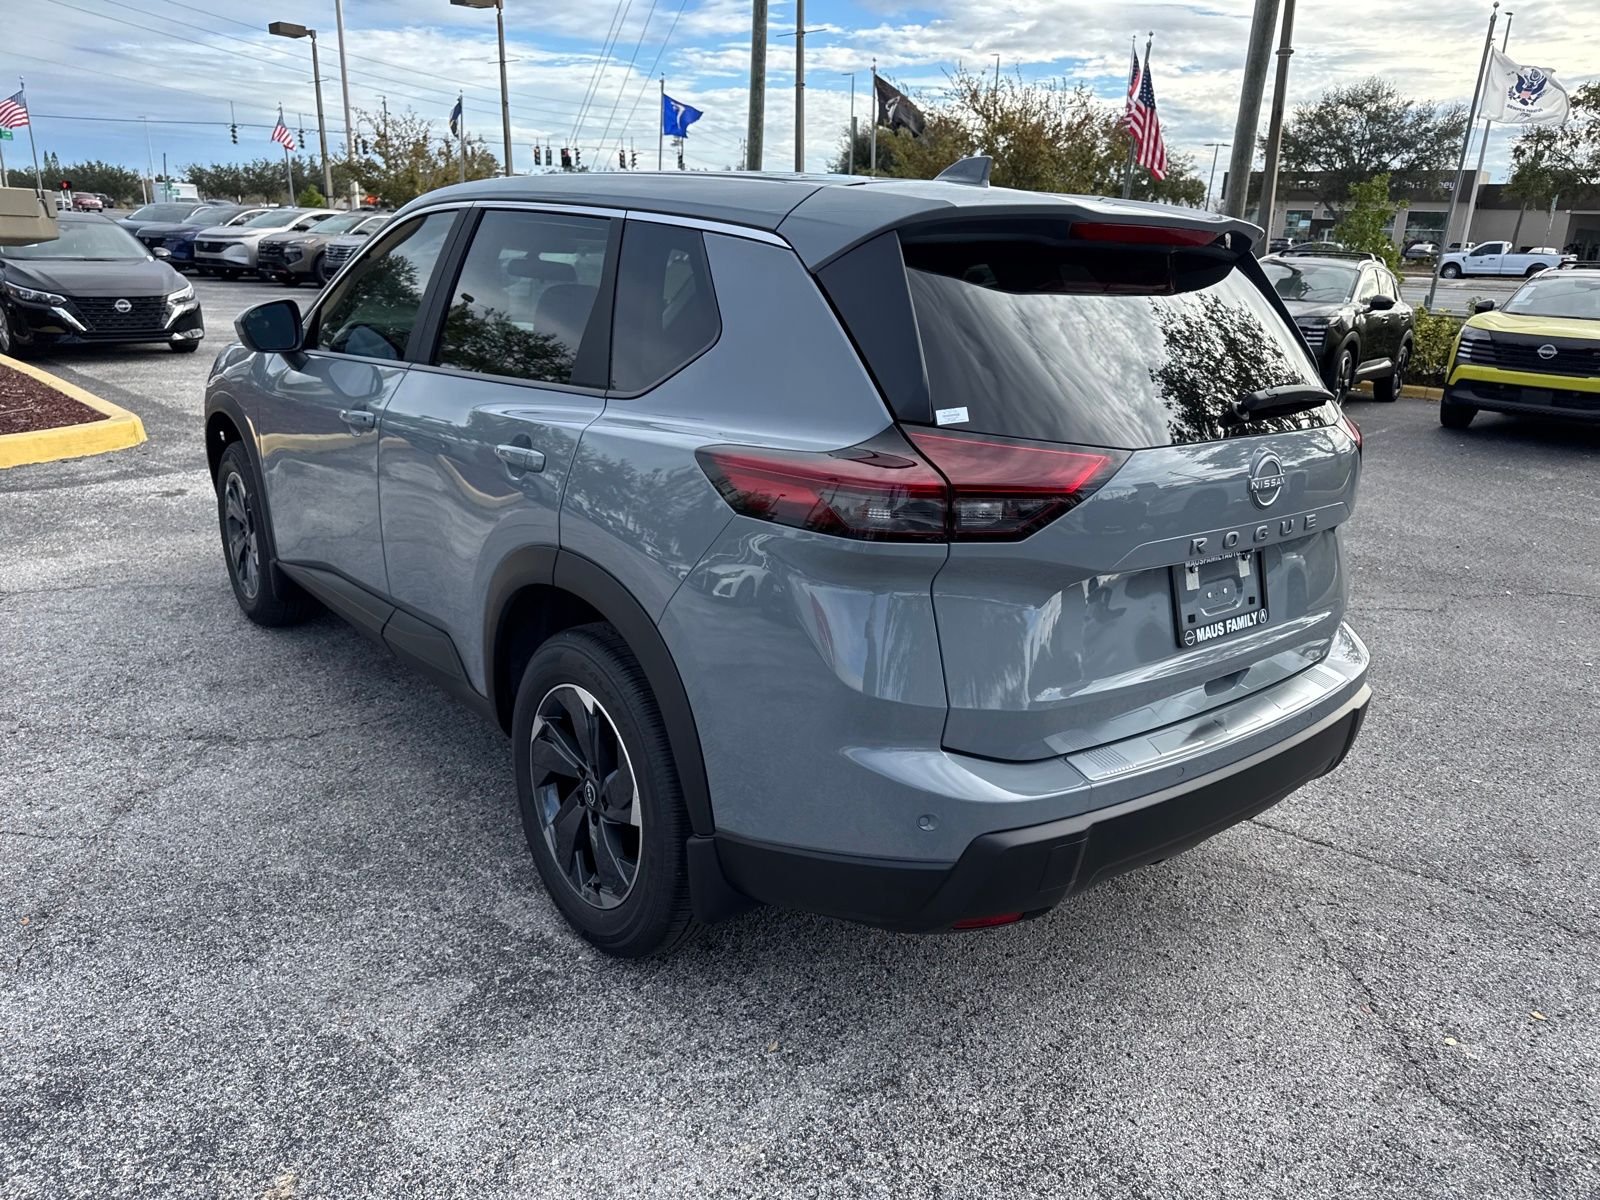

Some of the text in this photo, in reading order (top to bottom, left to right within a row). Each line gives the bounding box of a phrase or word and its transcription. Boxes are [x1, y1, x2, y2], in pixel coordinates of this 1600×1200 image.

[1251, 477, 1285, 490] NISSAN
[1190, 513, 1317, 555] ROGUE
[1196, 612, 1258, 642] MAUS FAMILY
